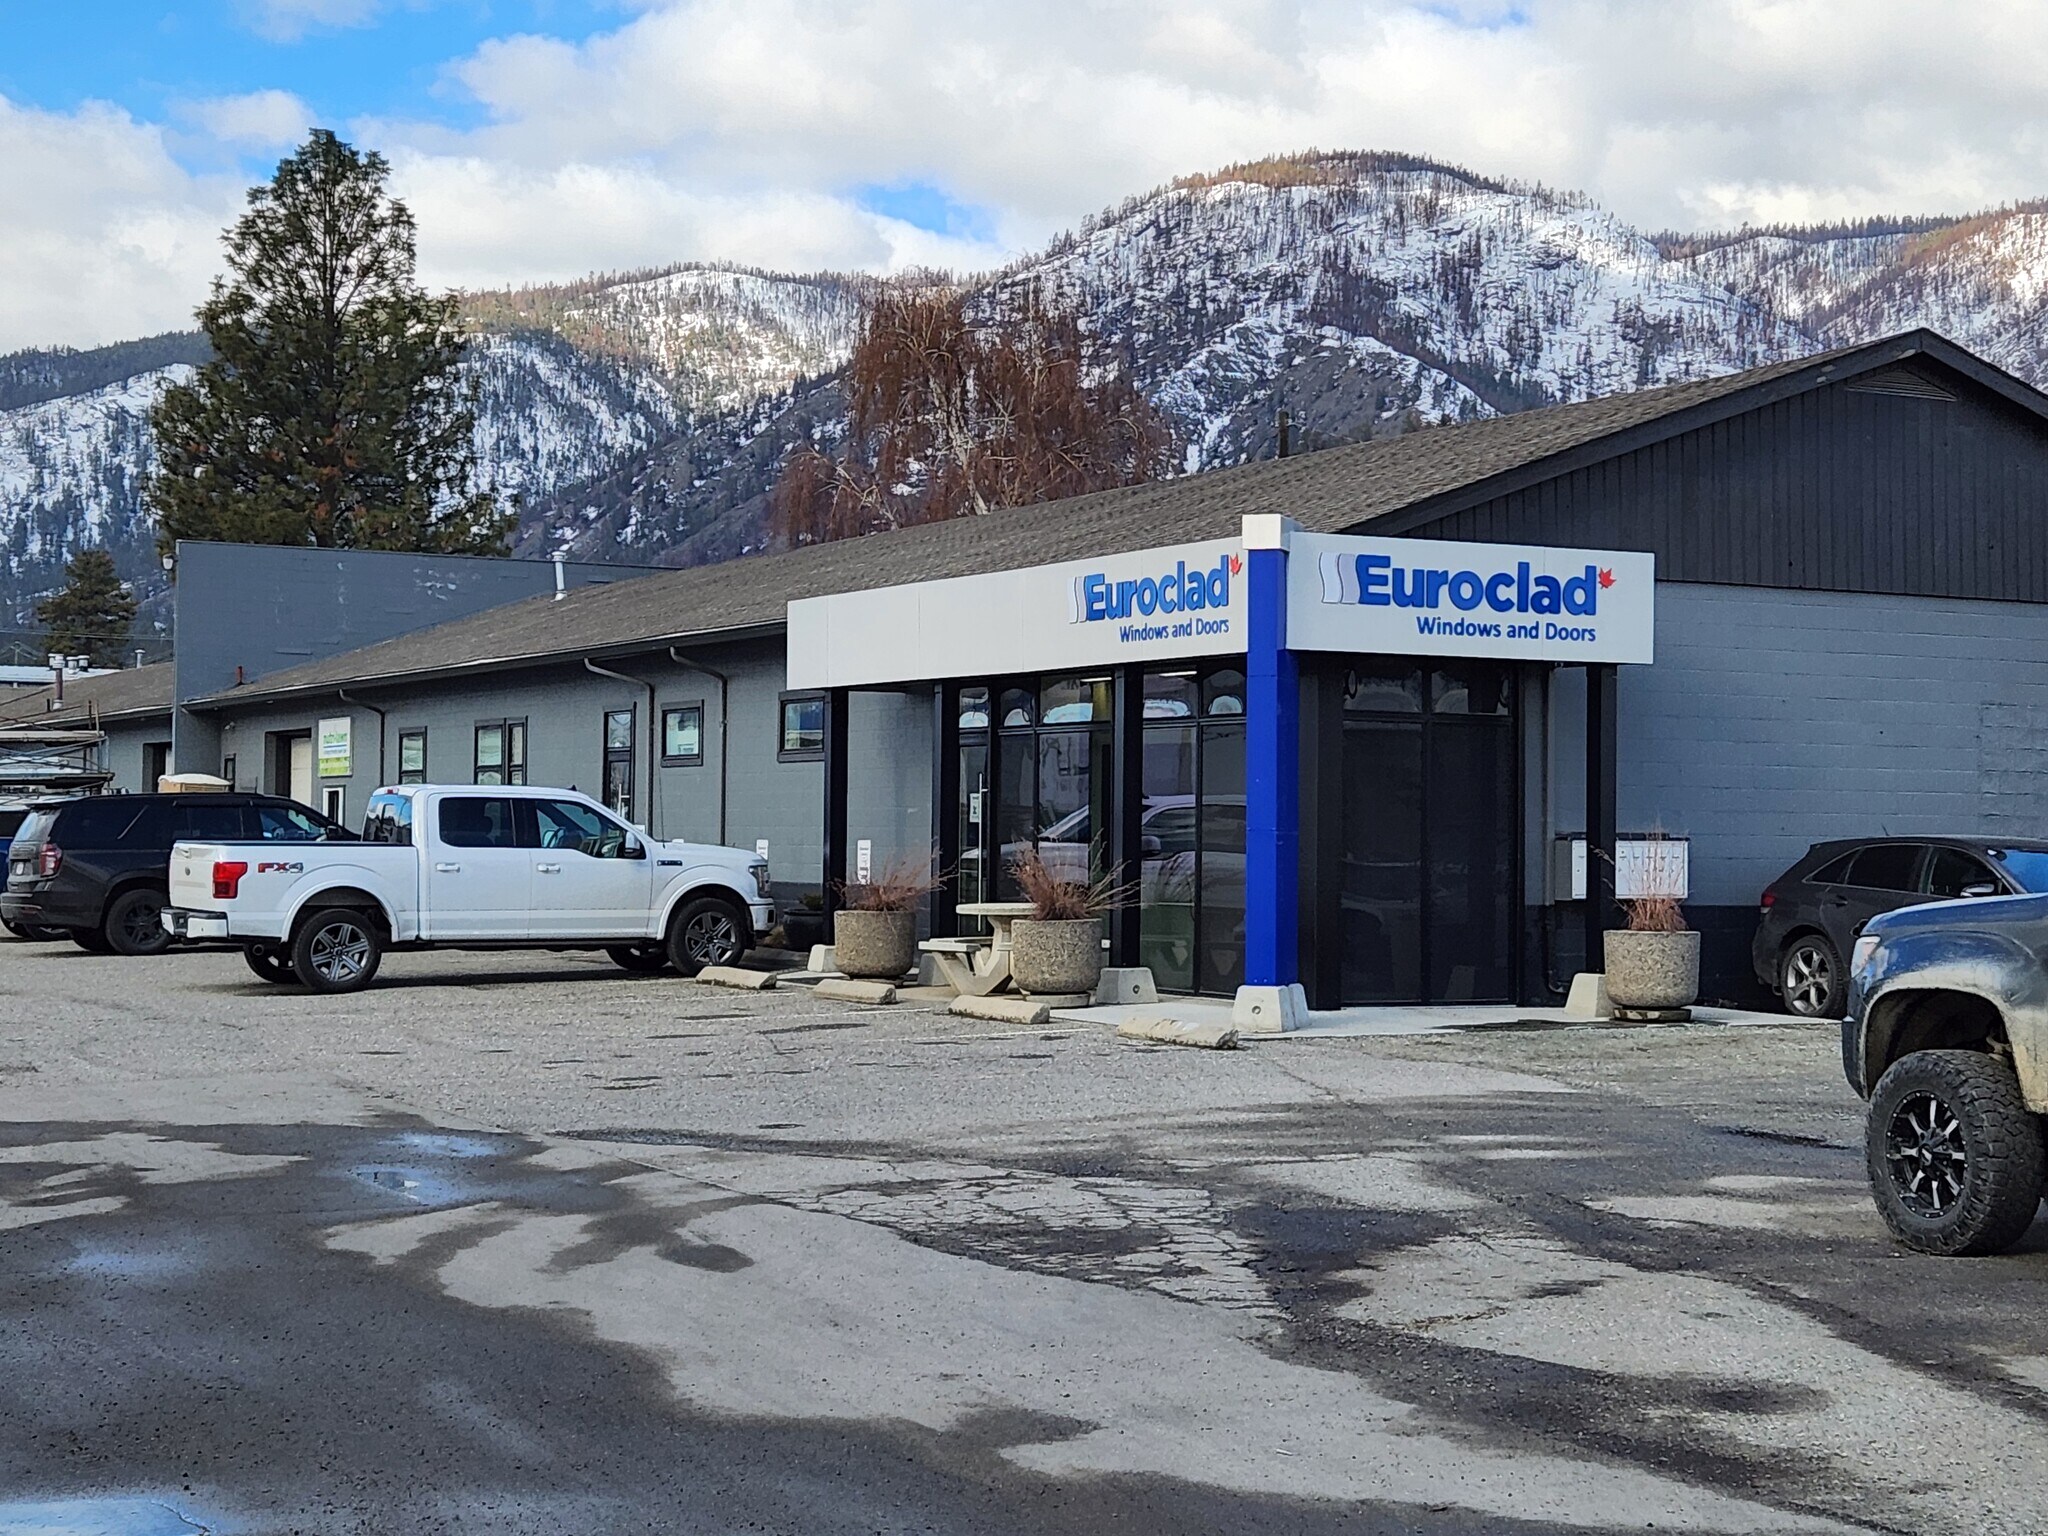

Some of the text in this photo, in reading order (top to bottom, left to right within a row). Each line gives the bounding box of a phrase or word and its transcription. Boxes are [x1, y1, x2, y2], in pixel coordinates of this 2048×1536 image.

[1084, 554, 1229, 621] Euroclad
[1355, 554, 1597, 616] Euroclad
[1120, 618, 1229, 643] Windows and Doors
[1416, 616, 1596, 642] Windows and Doors
[258, 862, 304, 873] FX4
